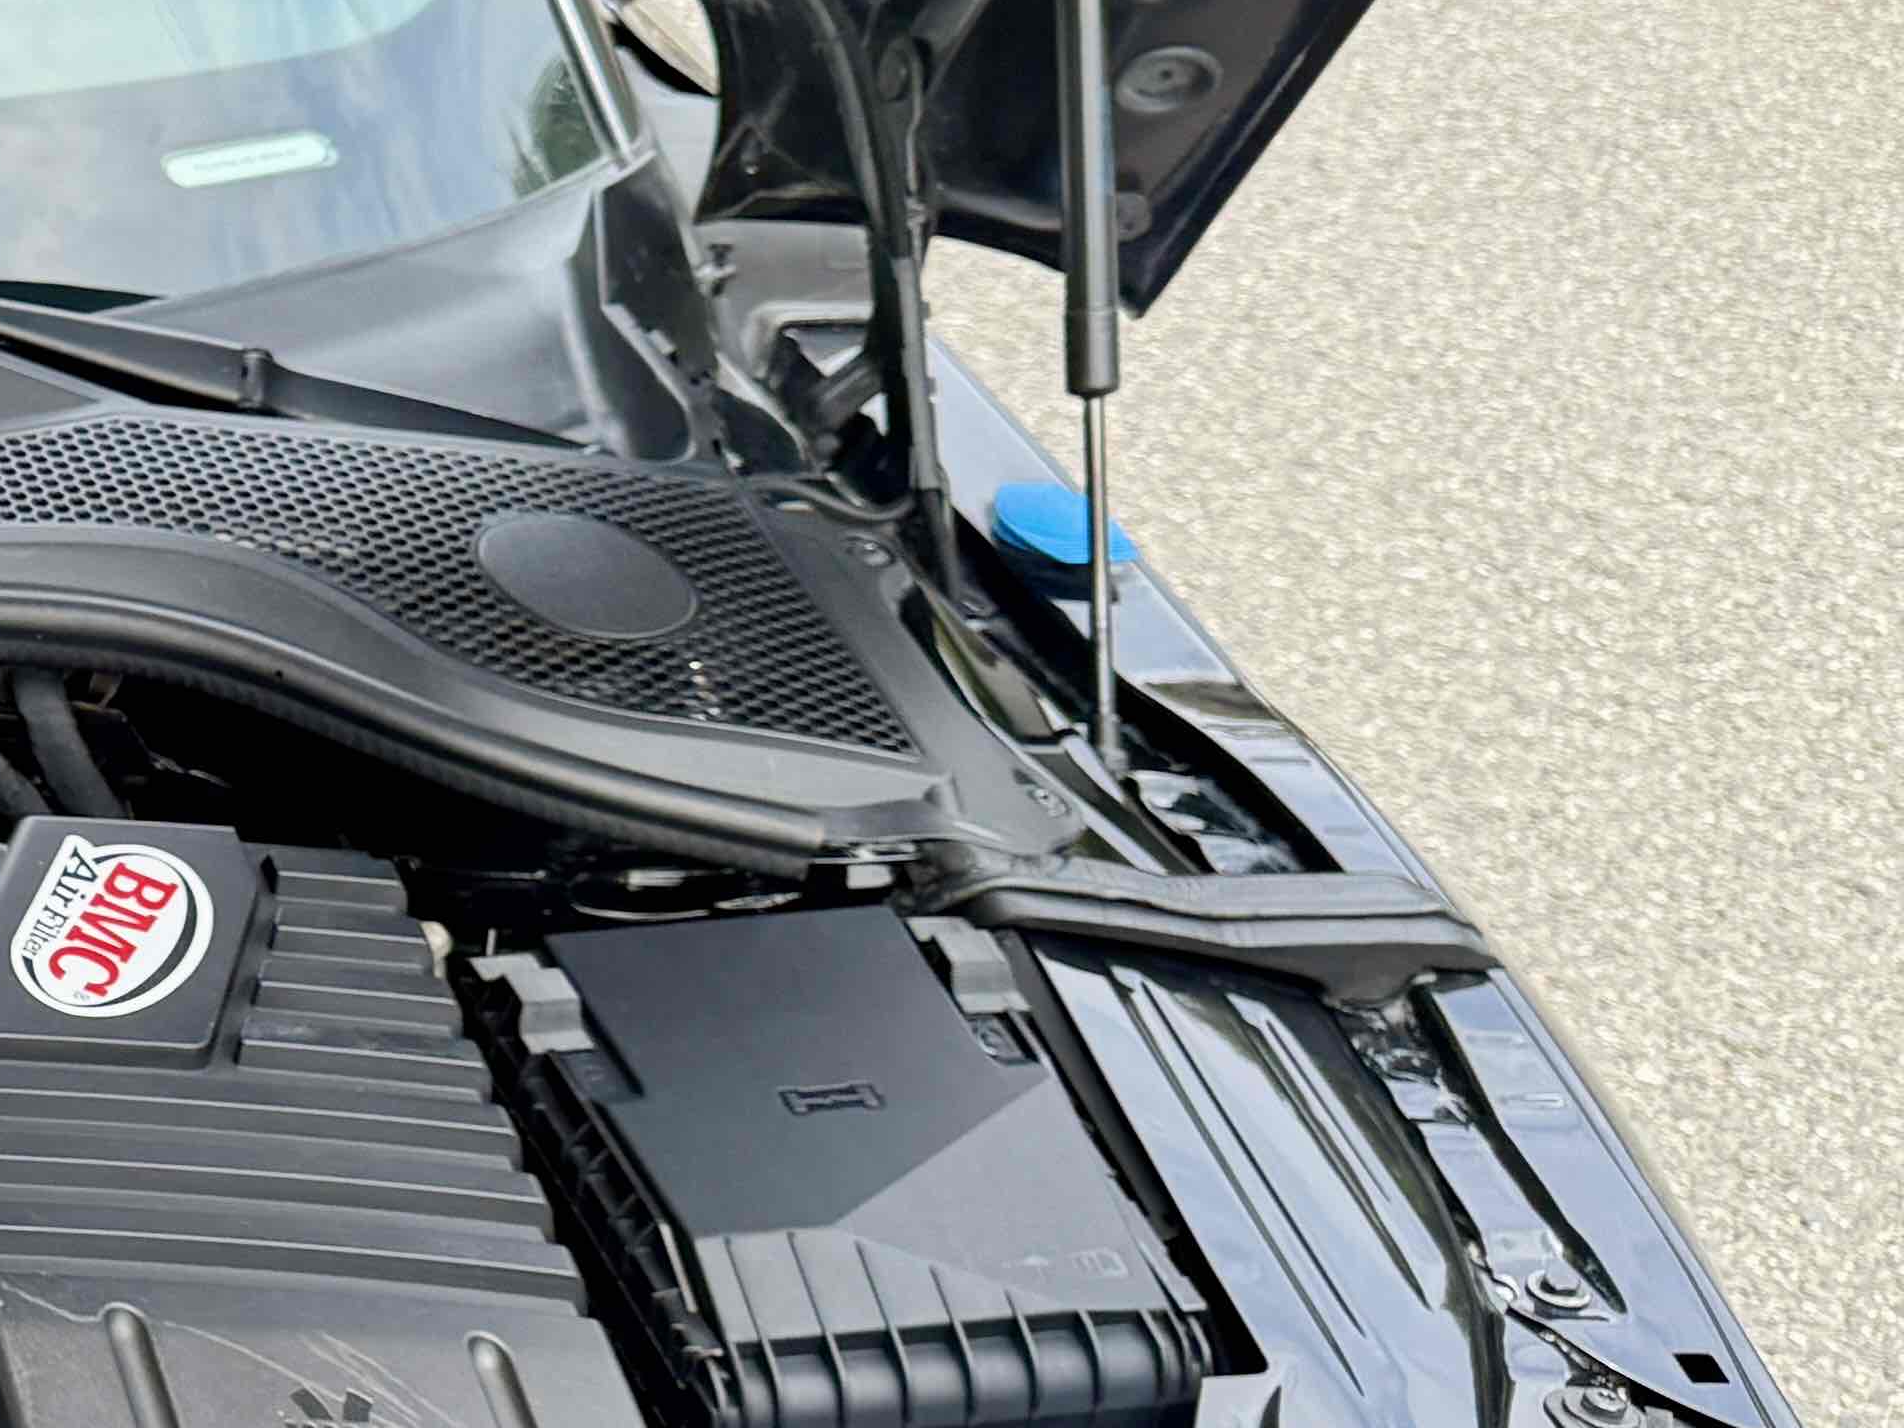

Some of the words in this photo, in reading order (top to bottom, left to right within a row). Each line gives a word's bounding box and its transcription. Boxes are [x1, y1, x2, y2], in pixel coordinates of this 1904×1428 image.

[50, 845, 99, 910] Air
[22, 903, 68, 958] Filter
[48, 862, 179, 997] BMC
